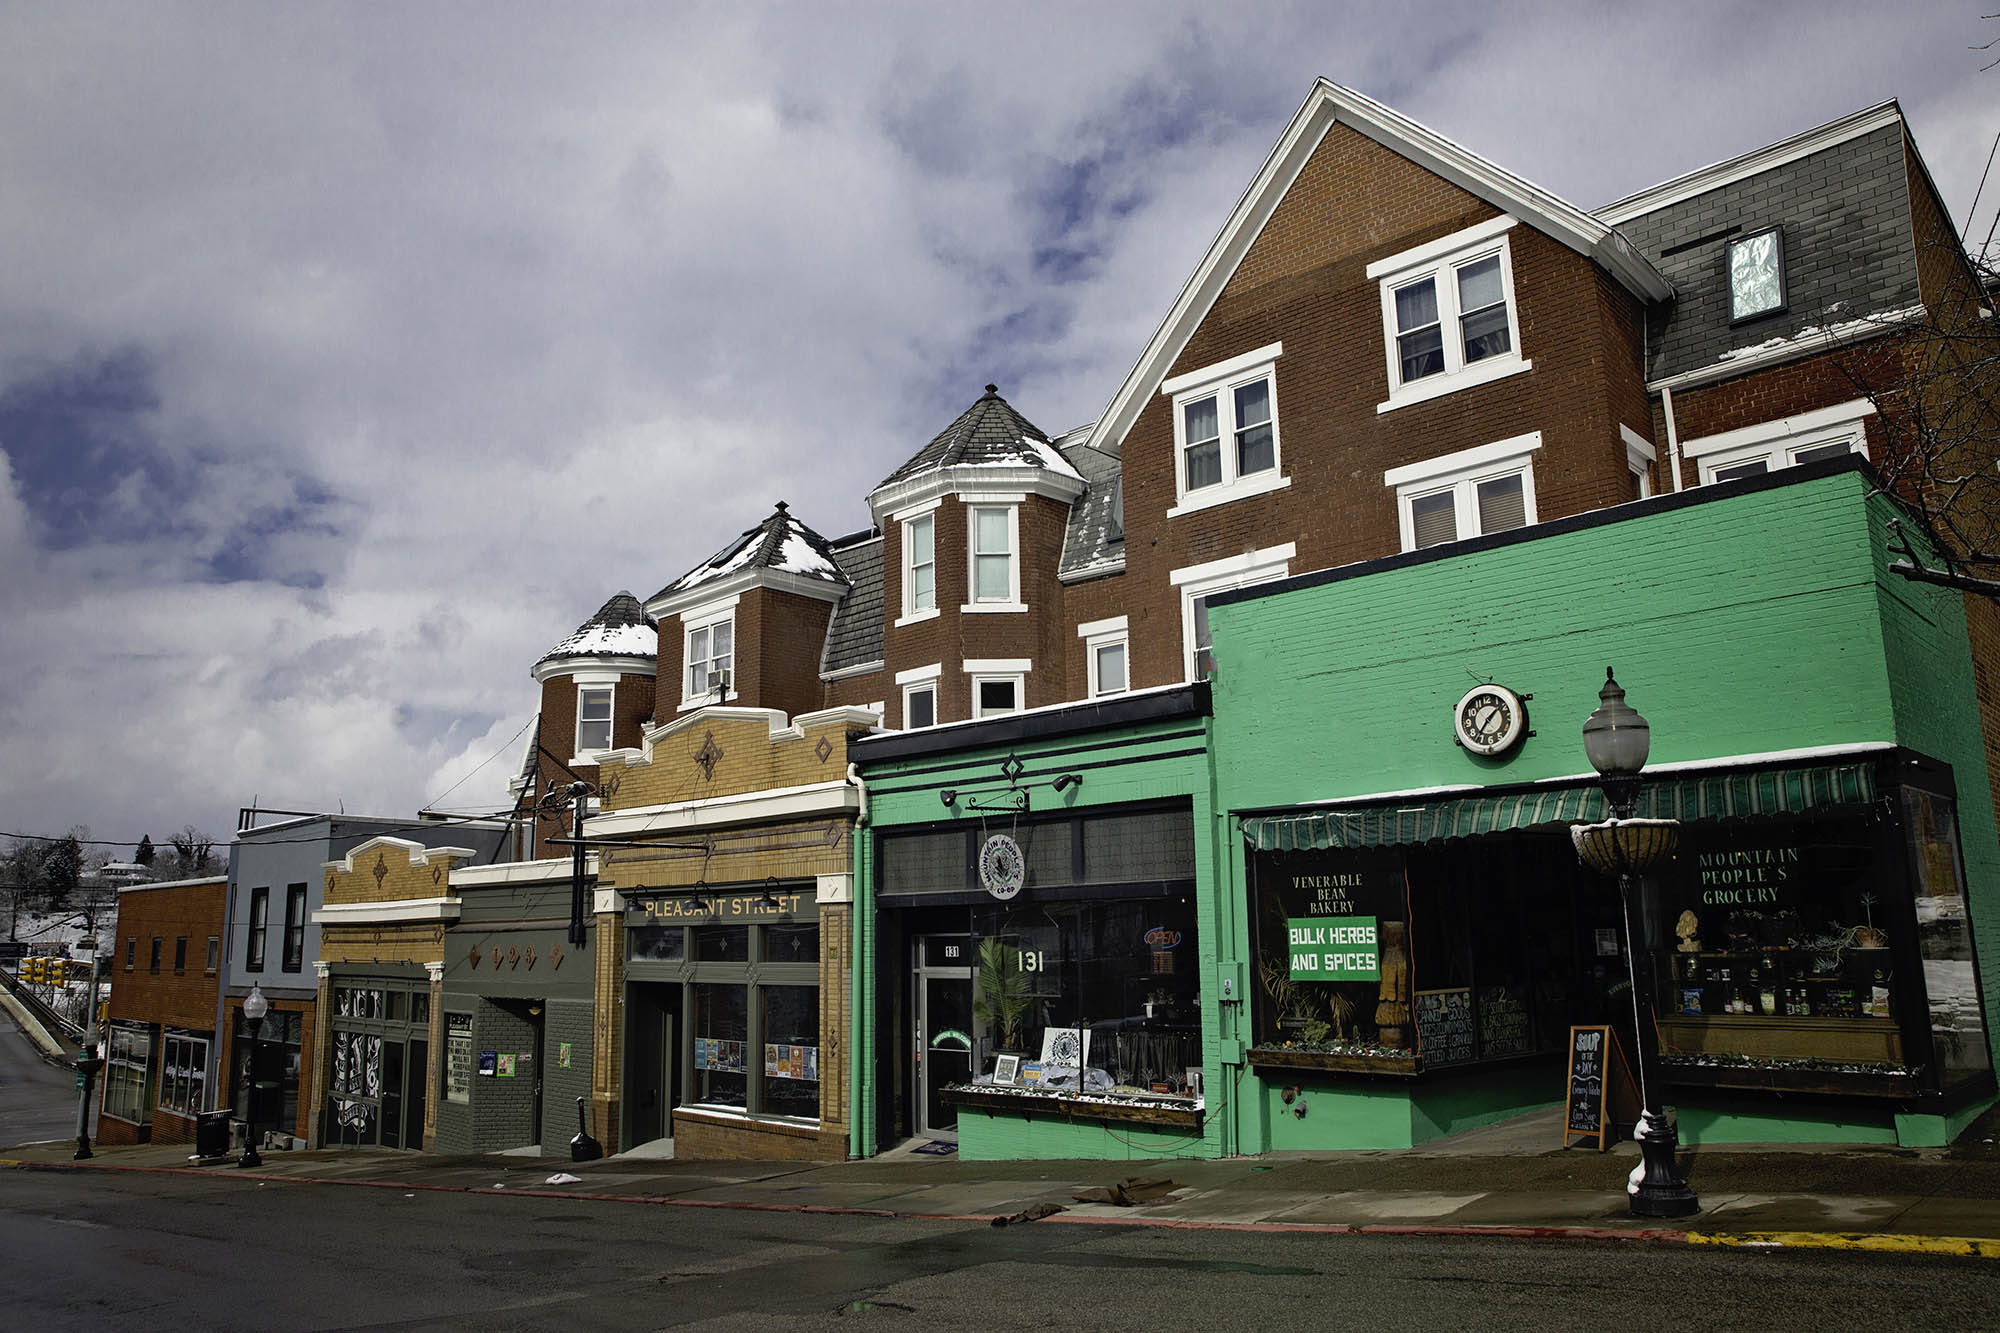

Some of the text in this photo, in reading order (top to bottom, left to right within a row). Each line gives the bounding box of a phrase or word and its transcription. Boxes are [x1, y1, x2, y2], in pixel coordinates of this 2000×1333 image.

[1475, 700, 1482, 708] 11
[1483, 696, 1491, 705] 12
[1468, 708, 1477, 717] 10
[1465, 719, 1472, 728] 9
[1470, 729, 1476, 737] 8
[1497, 732, 1503, 741] 5
[1488, 736, 1494, 745] 6
[1699, 848, 1798, 867] MOUNTAIN
[1292, 873, 1363, 889] VENERABLE
[1702, 866, 1787, 884] PEOPLE'S
[997, 886, 1015, 895] CO-OP
[1317, 888, 1346, 901] BEAN
[1703, 887, 1779, 904] GROCERY
[731, 896, 801, 914] STREET
[1310, 901, 1355, 914] BAKERY
[1147, 930, 1178, 945] OPEN
[1289, 926, 1377, 945] BULK HERBS
[945, 946, 959, 957] 131
[1018, 951, 1044, 972] 131
[1291, 953, 1377, 971] AND SPICES
[1575, 1032, 1601, 1052] SOUP
[1580, 1061, 1593, 1075] DAY
